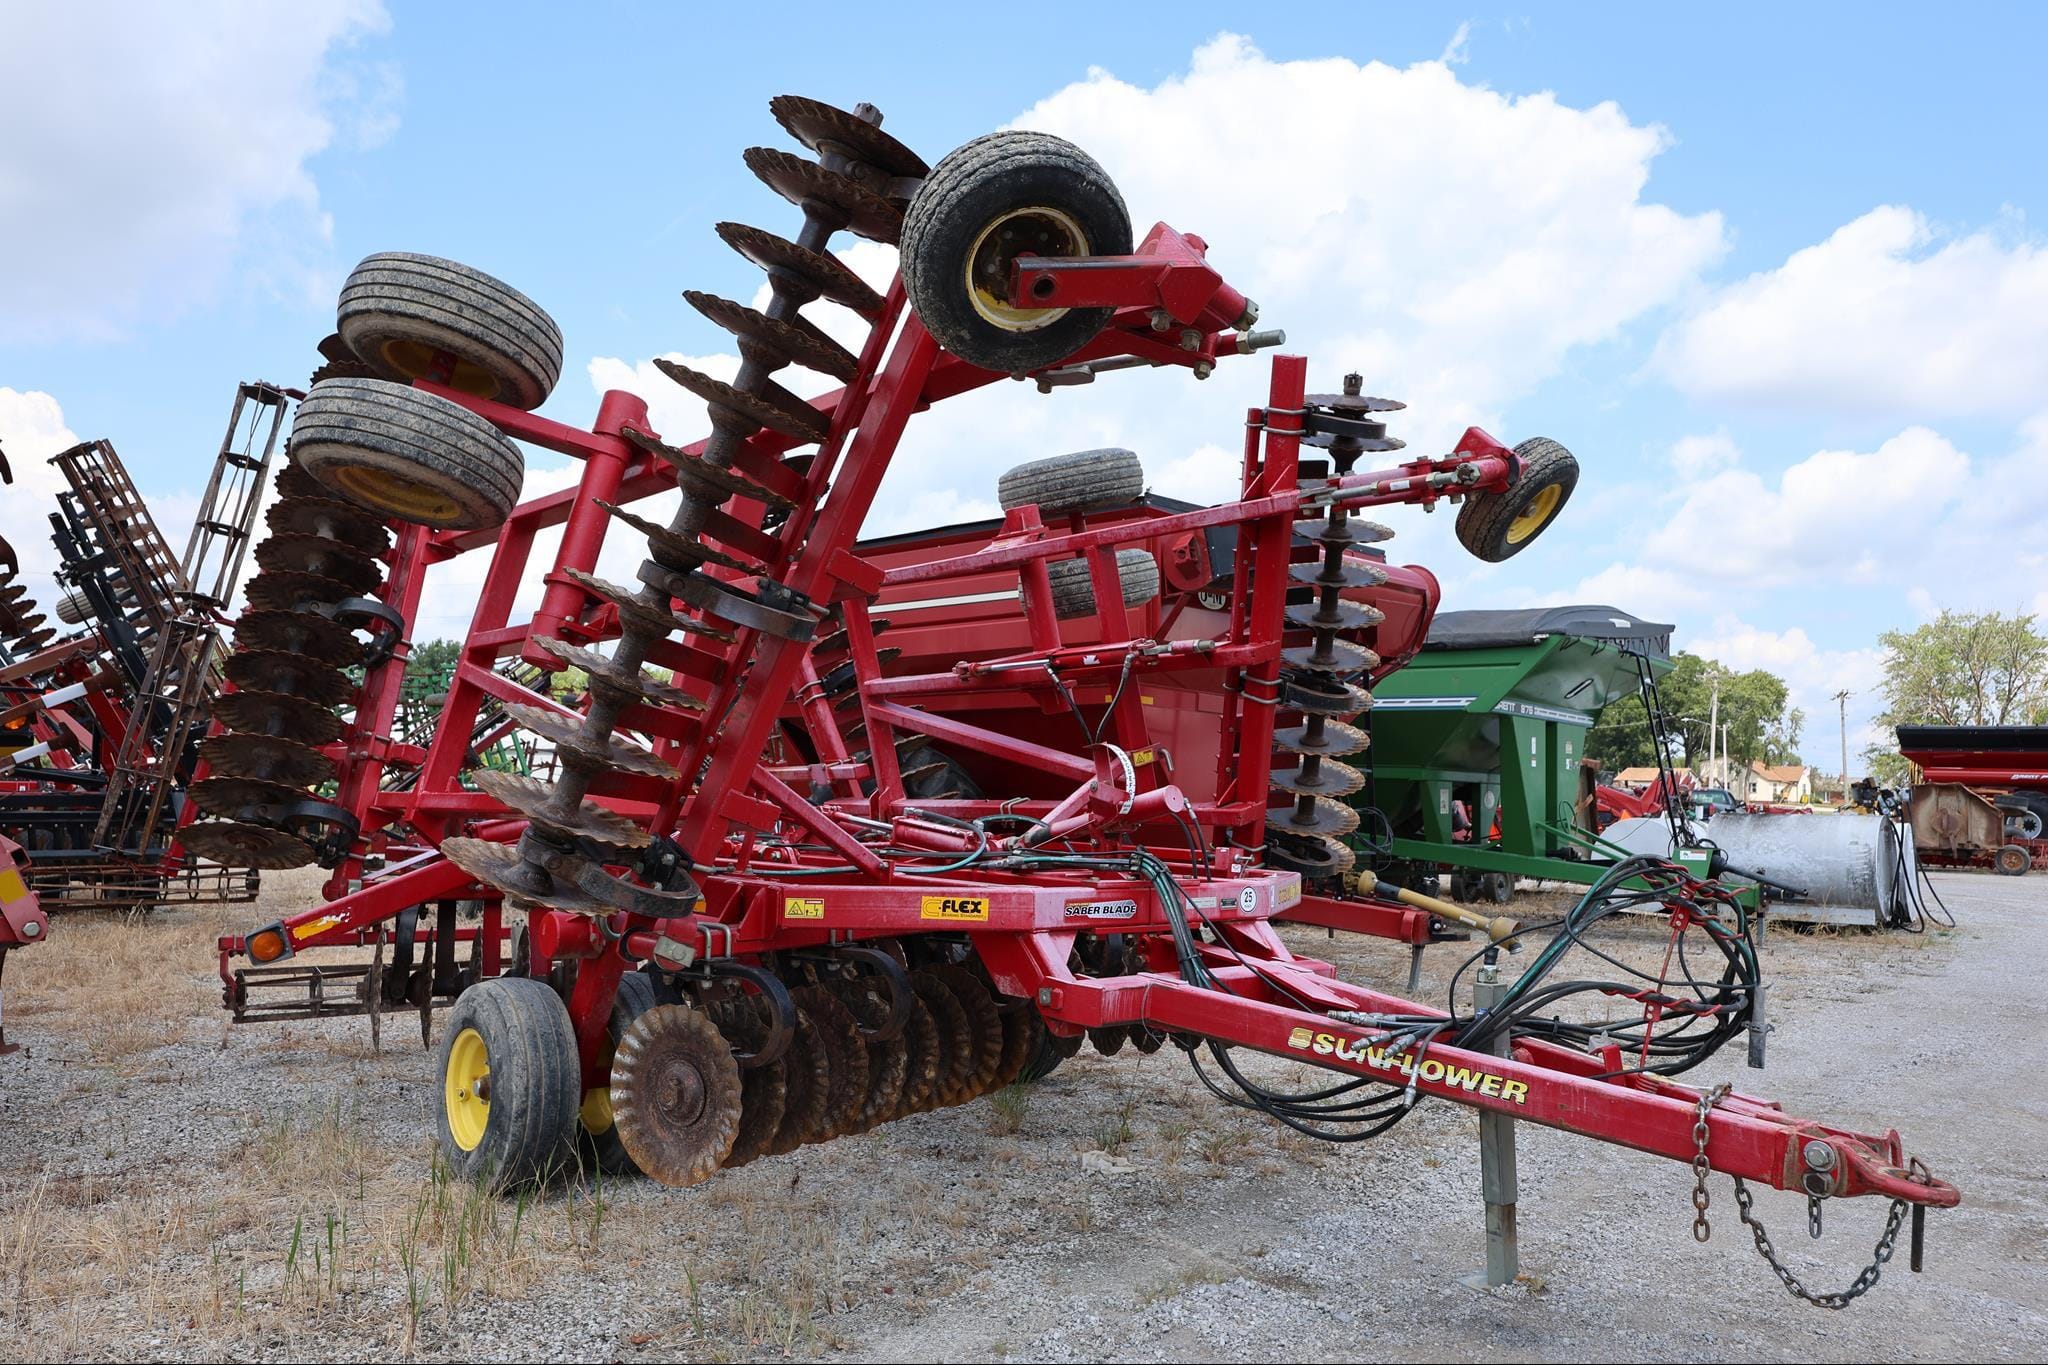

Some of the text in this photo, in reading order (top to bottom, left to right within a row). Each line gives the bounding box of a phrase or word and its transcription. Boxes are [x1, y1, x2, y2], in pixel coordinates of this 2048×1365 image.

[1244, 891, 1253, 903] 25
[1065, 905, 1136, 916] SABER BLADE
